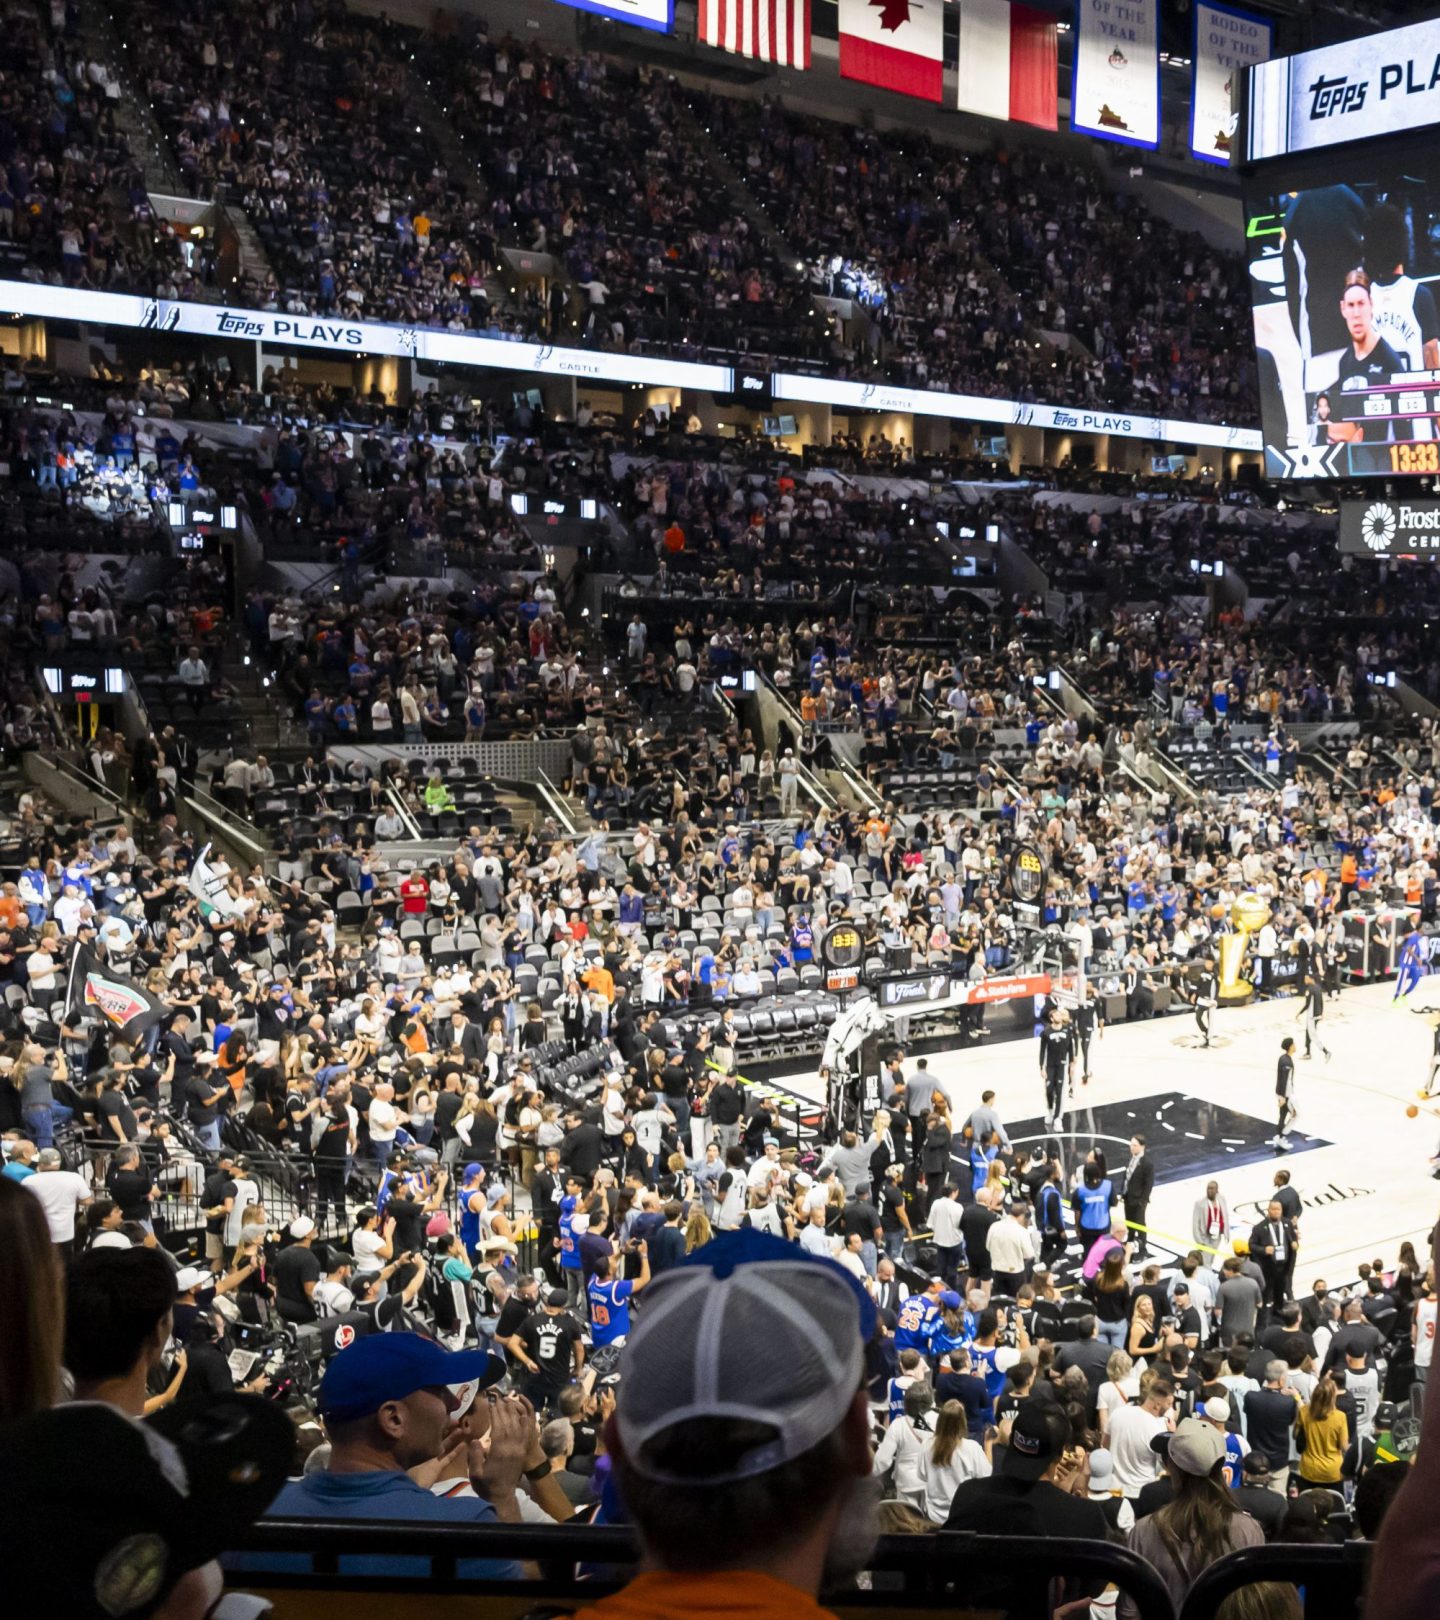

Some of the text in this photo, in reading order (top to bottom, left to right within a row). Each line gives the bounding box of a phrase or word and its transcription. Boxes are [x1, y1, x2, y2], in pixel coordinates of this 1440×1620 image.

[1116, 6, 1145, 25] THE
[1210, 14, 1258, 38] RODEO
[1099, 20, 1136, 42] YEAR
[1209, 32, 1259, 58] OF THE
[273, 320, 363, 345] PLAYS
[558, 362, 601, 374] CASTLE
[879, 399, 913, 410] CASTLE
[1083, 414, 1132, 433] PLAYS
[1389, 443, 1440, 473] 13:33
[1399, 506, 1440, 530] Frost
[832, 933, 857, 948] 13:33
[536, 1322, 563, 1337] CASTLE
[898, 1307, 924, 1333] 25
[1424, 1321, 1436, 1340] 3
[539, 1335, 558, 1360] 5
